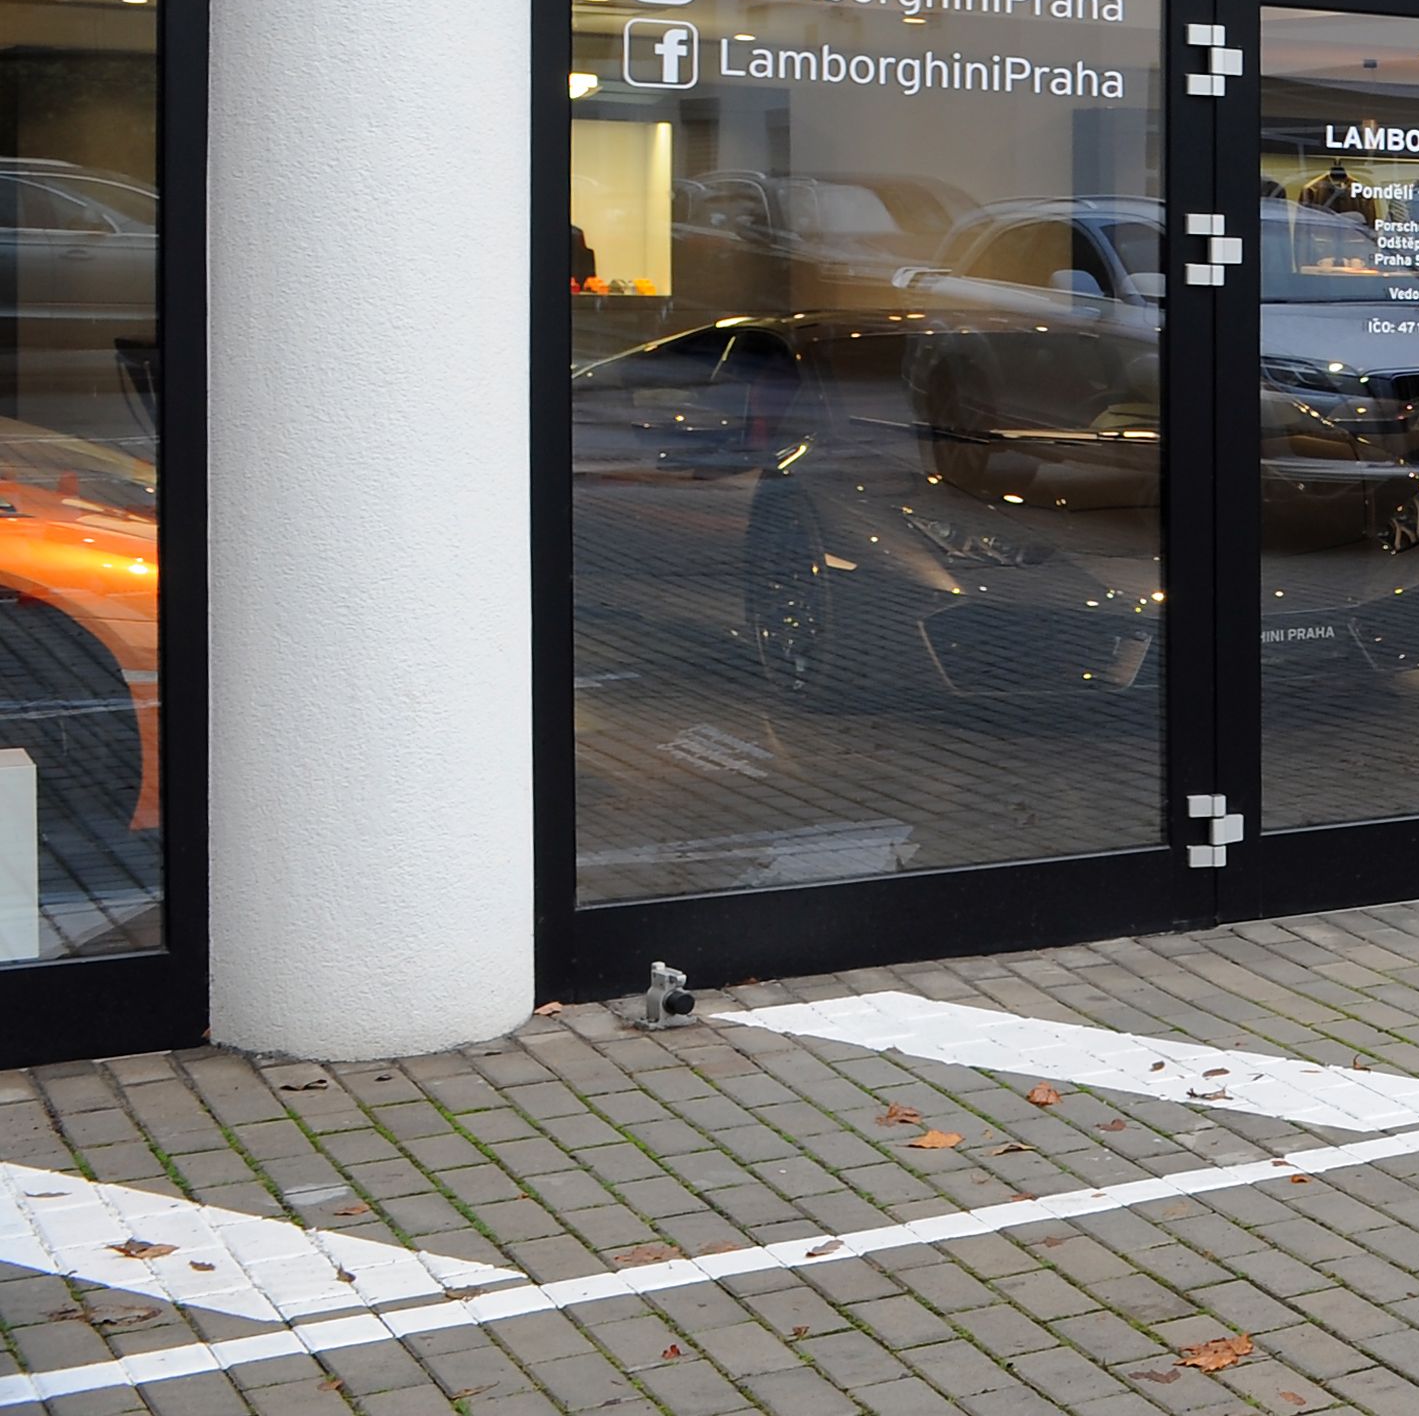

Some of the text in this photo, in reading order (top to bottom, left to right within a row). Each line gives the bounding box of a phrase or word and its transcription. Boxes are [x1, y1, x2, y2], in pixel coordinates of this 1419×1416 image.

[720, 38, 1124, 99] LamborghiniPraha
[1351, 182, 1414, 200] Pondělí
[1374, 253, 1412, 266] Praha
[1287, 625, 1335, 641] PRAHA
